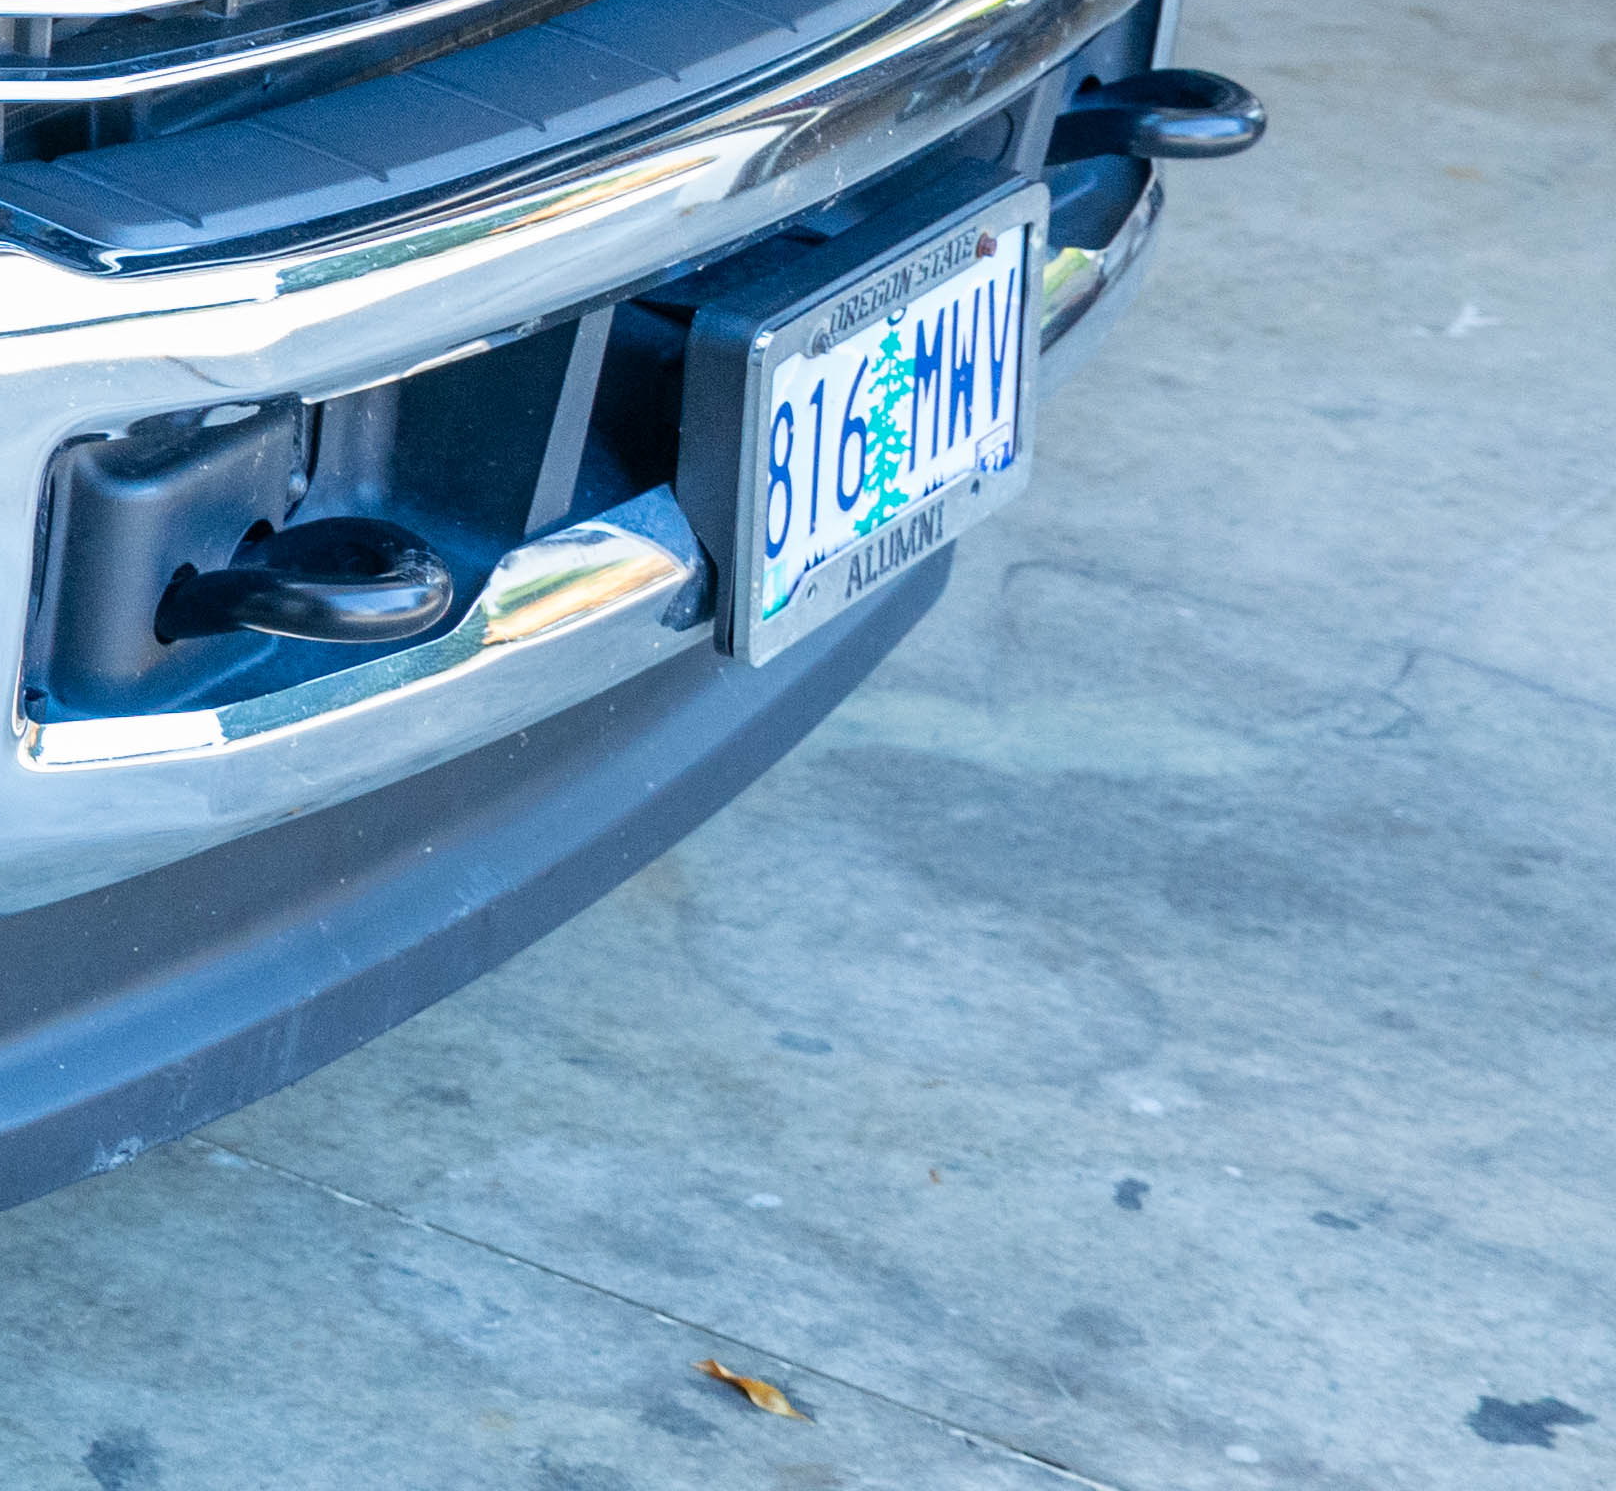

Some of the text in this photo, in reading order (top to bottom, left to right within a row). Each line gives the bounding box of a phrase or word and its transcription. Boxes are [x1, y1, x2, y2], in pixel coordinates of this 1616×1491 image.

[915, 226, 978, 287] STATE
[766, 267, 1018, 560] 816 MWV
[844, 498, 946, 600] ALUMNI
